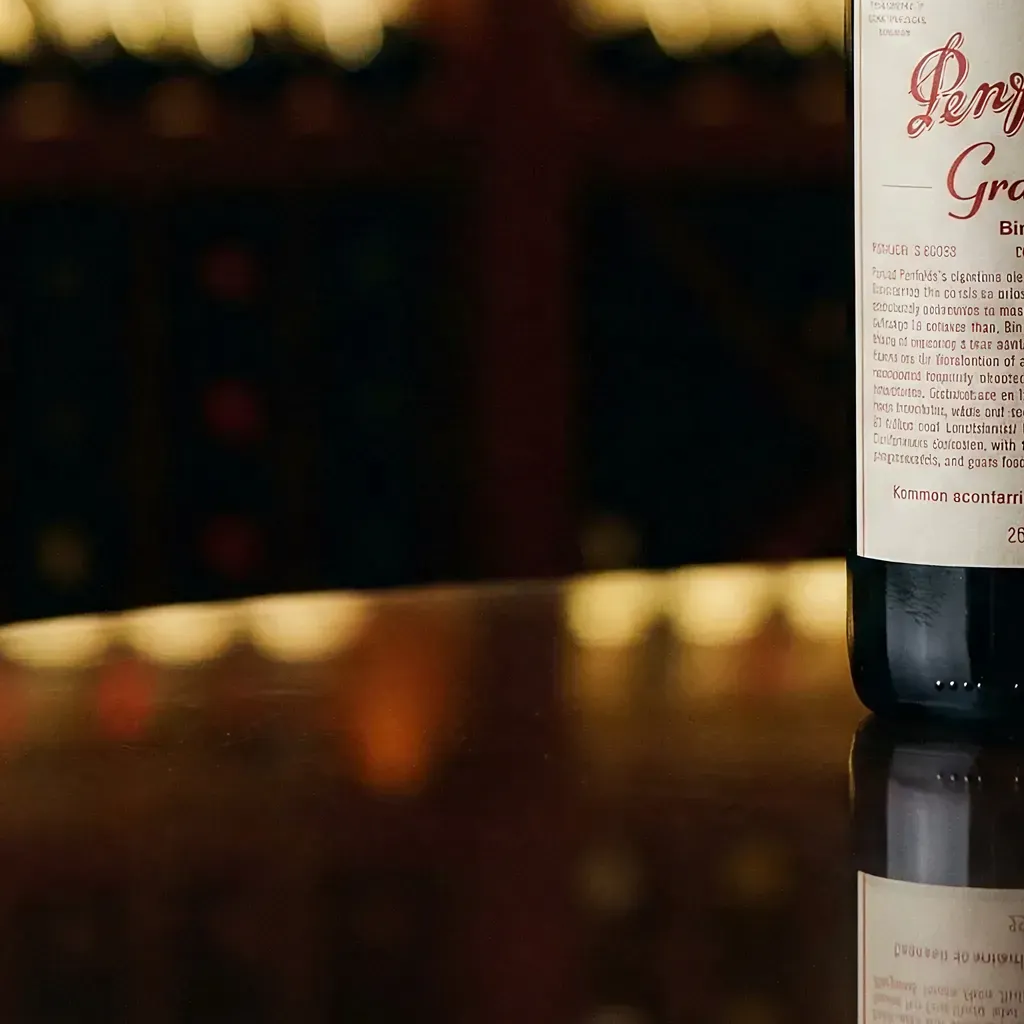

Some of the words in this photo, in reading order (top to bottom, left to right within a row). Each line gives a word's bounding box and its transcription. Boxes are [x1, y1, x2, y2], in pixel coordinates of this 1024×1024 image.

[1004, 320, 1023, 334] Bin
[1003, 354, 1016, 368] of
[1000, 391, 1015, 402] en
[990, 438, 1017, 451] with
[893, 484, 948, 503] Kommon
